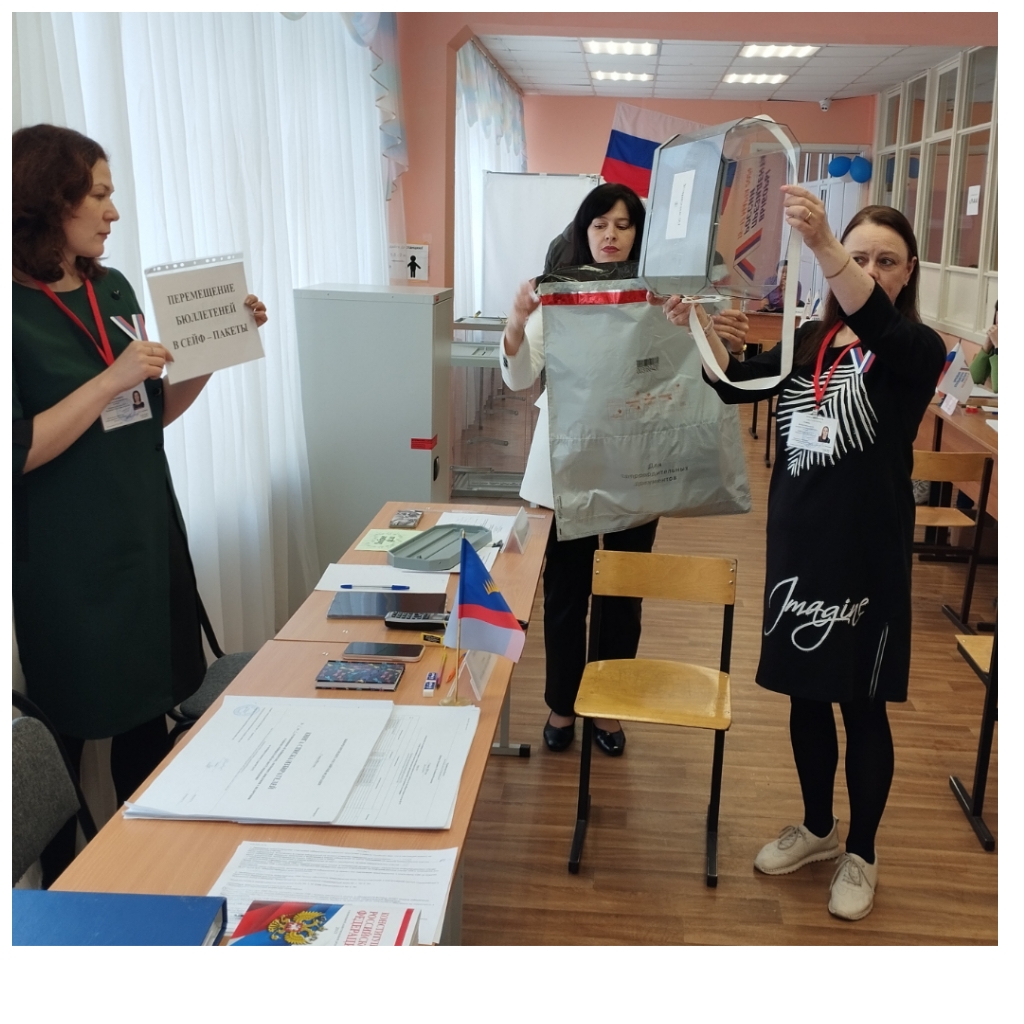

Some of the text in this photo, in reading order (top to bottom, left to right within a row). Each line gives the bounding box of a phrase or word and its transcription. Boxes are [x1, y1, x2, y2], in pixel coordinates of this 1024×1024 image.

[167, 283, 235, 305] ПЕРЕМЕЩЕНИЕ
[176, 303, 236, 325] БЮЛЛЕТЕНЕЙ
[173, 341, 179, 350] В
[181, 334, 206, 348] СЕЙФ
[213, 323, 248, 340] ПАКЕТЫ
[764, 576, 869, 651] Imagine
